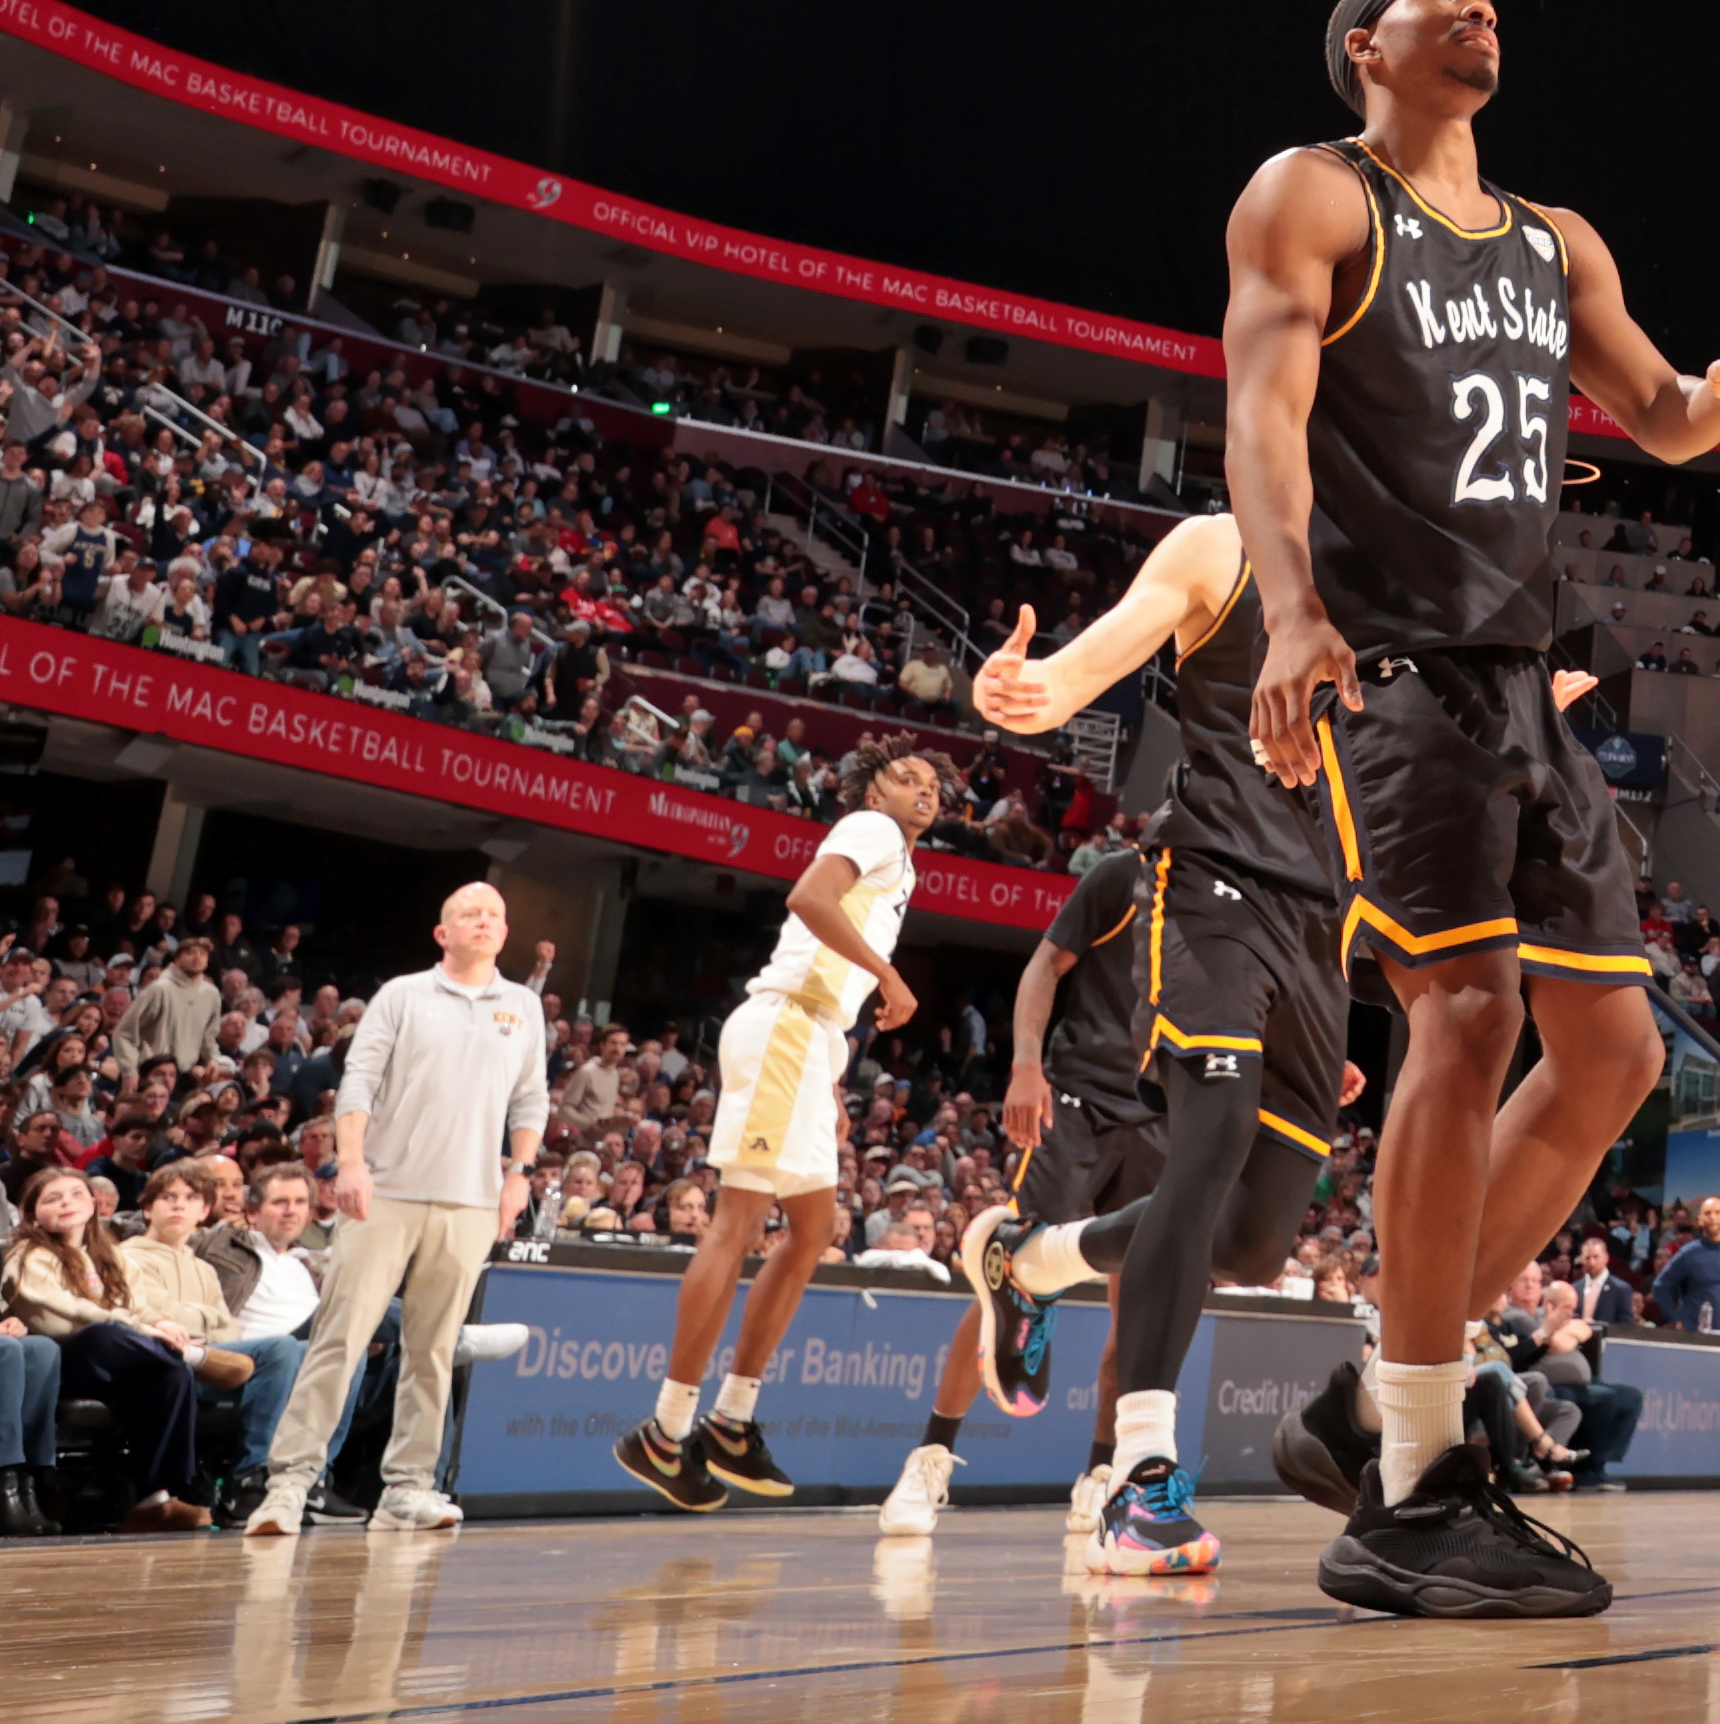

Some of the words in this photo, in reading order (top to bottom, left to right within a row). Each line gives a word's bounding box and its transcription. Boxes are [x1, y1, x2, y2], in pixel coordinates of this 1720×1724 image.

[47, 16, 78, 41] OF
[84, 30, 122, 64] THE
[129, 49, 180, 88] MAC
[186, 72, 331, 136] BASKETBALL
[339, 119, 494, 184] TOURNAMENT
[593, 201, 679, 245] OFFICIAL
[685, 228, 719, 251] VIP
[723, 241, 792, 274] HOTEL
[798, 259, 828, 278] OF
[836, 265, 875, 292] THE
[882, 275, 929, 304] MAC
[934, 288, 1060, 334] BASKETBALL
[1065, 317, 1199, 363] TOURNAMENT
[1405, 278, 1498, 350] Kent
[1497, 276, 1569, 360] State
[1451, 372, 1551, 506] 25
[29, 650, 79, 687] OF
[91, 661, 155, 709] THE
[165, 681, 239, 728] MAC
[247, 700, 427, 775] BASKETBALL
[440, 747, 617, 816] TOURNAMENT
[990, 882, 1024, 907] OF
[508, 1241, 550, 1263] anc
[515, 1325, 673, 1381] Discove
[800, 1338, 926, 1401] Banking
[1217, 1378, 1280, 1415] Credit
